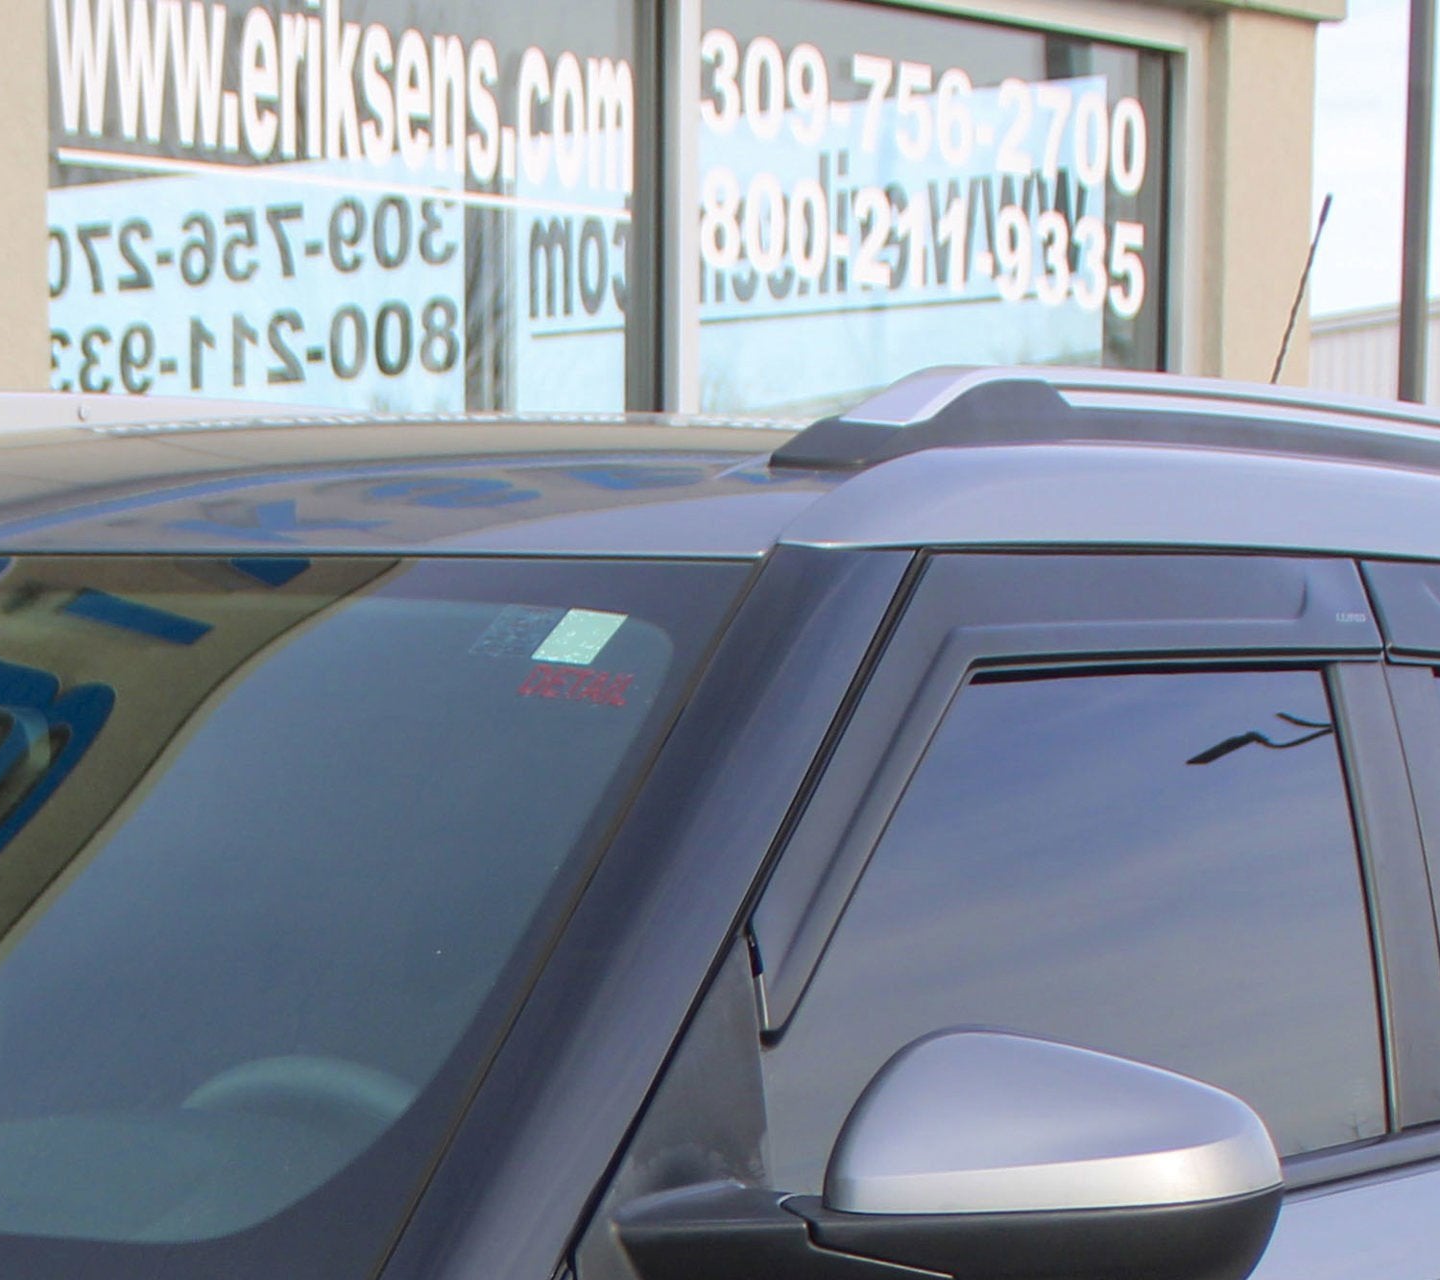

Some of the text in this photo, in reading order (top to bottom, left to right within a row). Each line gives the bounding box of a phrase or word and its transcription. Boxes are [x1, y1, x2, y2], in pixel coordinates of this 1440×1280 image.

[51, 0, 635, 195] www.eriksens.com
[701, 28, 1147, 196] 309-756-2700
[701, 165, 1145, 319] 800-211-9335
